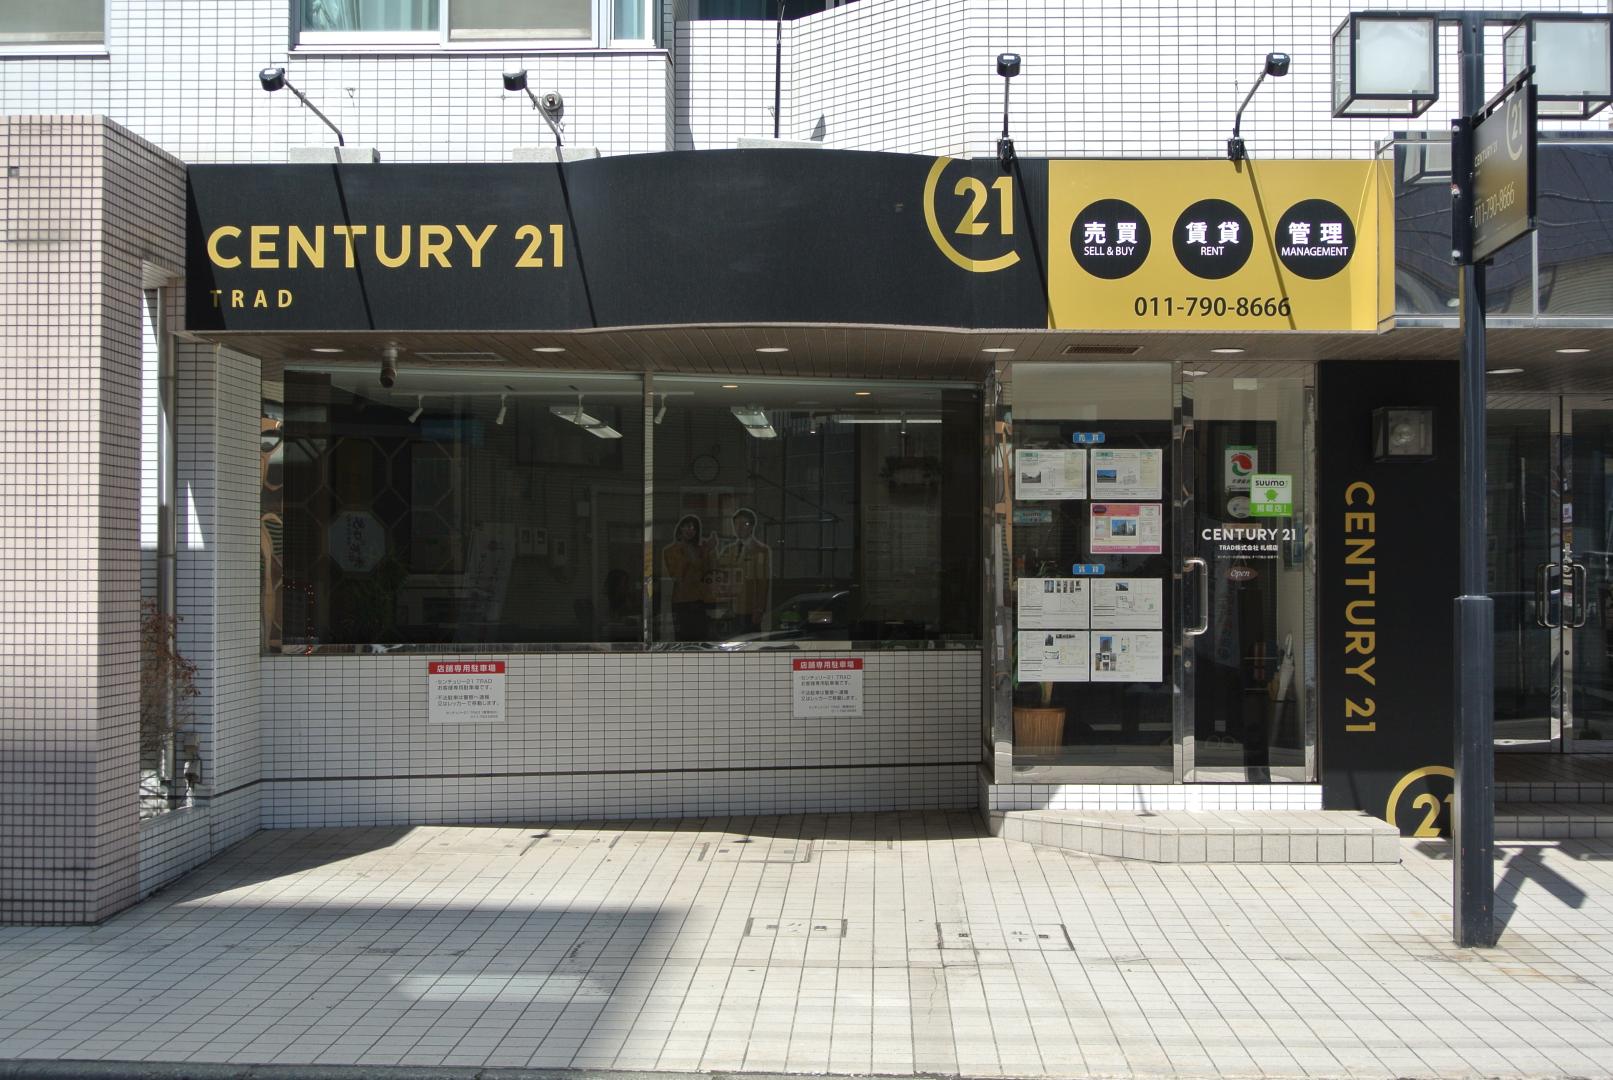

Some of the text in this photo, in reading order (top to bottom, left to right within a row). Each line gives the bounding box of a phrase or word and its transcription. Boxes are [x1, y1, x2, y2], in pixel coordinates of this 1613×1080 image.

[1511, 98, 1523, 140] 21
[954, 175, 1014, 236] 21
[1083, 221, 1138, 245] 売買
[1185, 221, 1240, 245] 賃貸
[1288, 221, 1343, 245] 管理
[207, 224, 565, 269] CENTURY 21
[1083, 246, 1135, 256] SELL & BUY
[1200, 246, 1225, 256] RENT
[1281, 246, 1349, 257] MANAGEMENT
[210, 288, 294, 309] TRAD
[1133, 296, 1292, 317] 011-790-8666
[1255, 479, 1285, 487] suumo
[1201, 528, 1296, 541] CENTURY 21
[1230, 569, 1251, 579] Open
[1344, 481, 1376, 732] CENTURY 21
